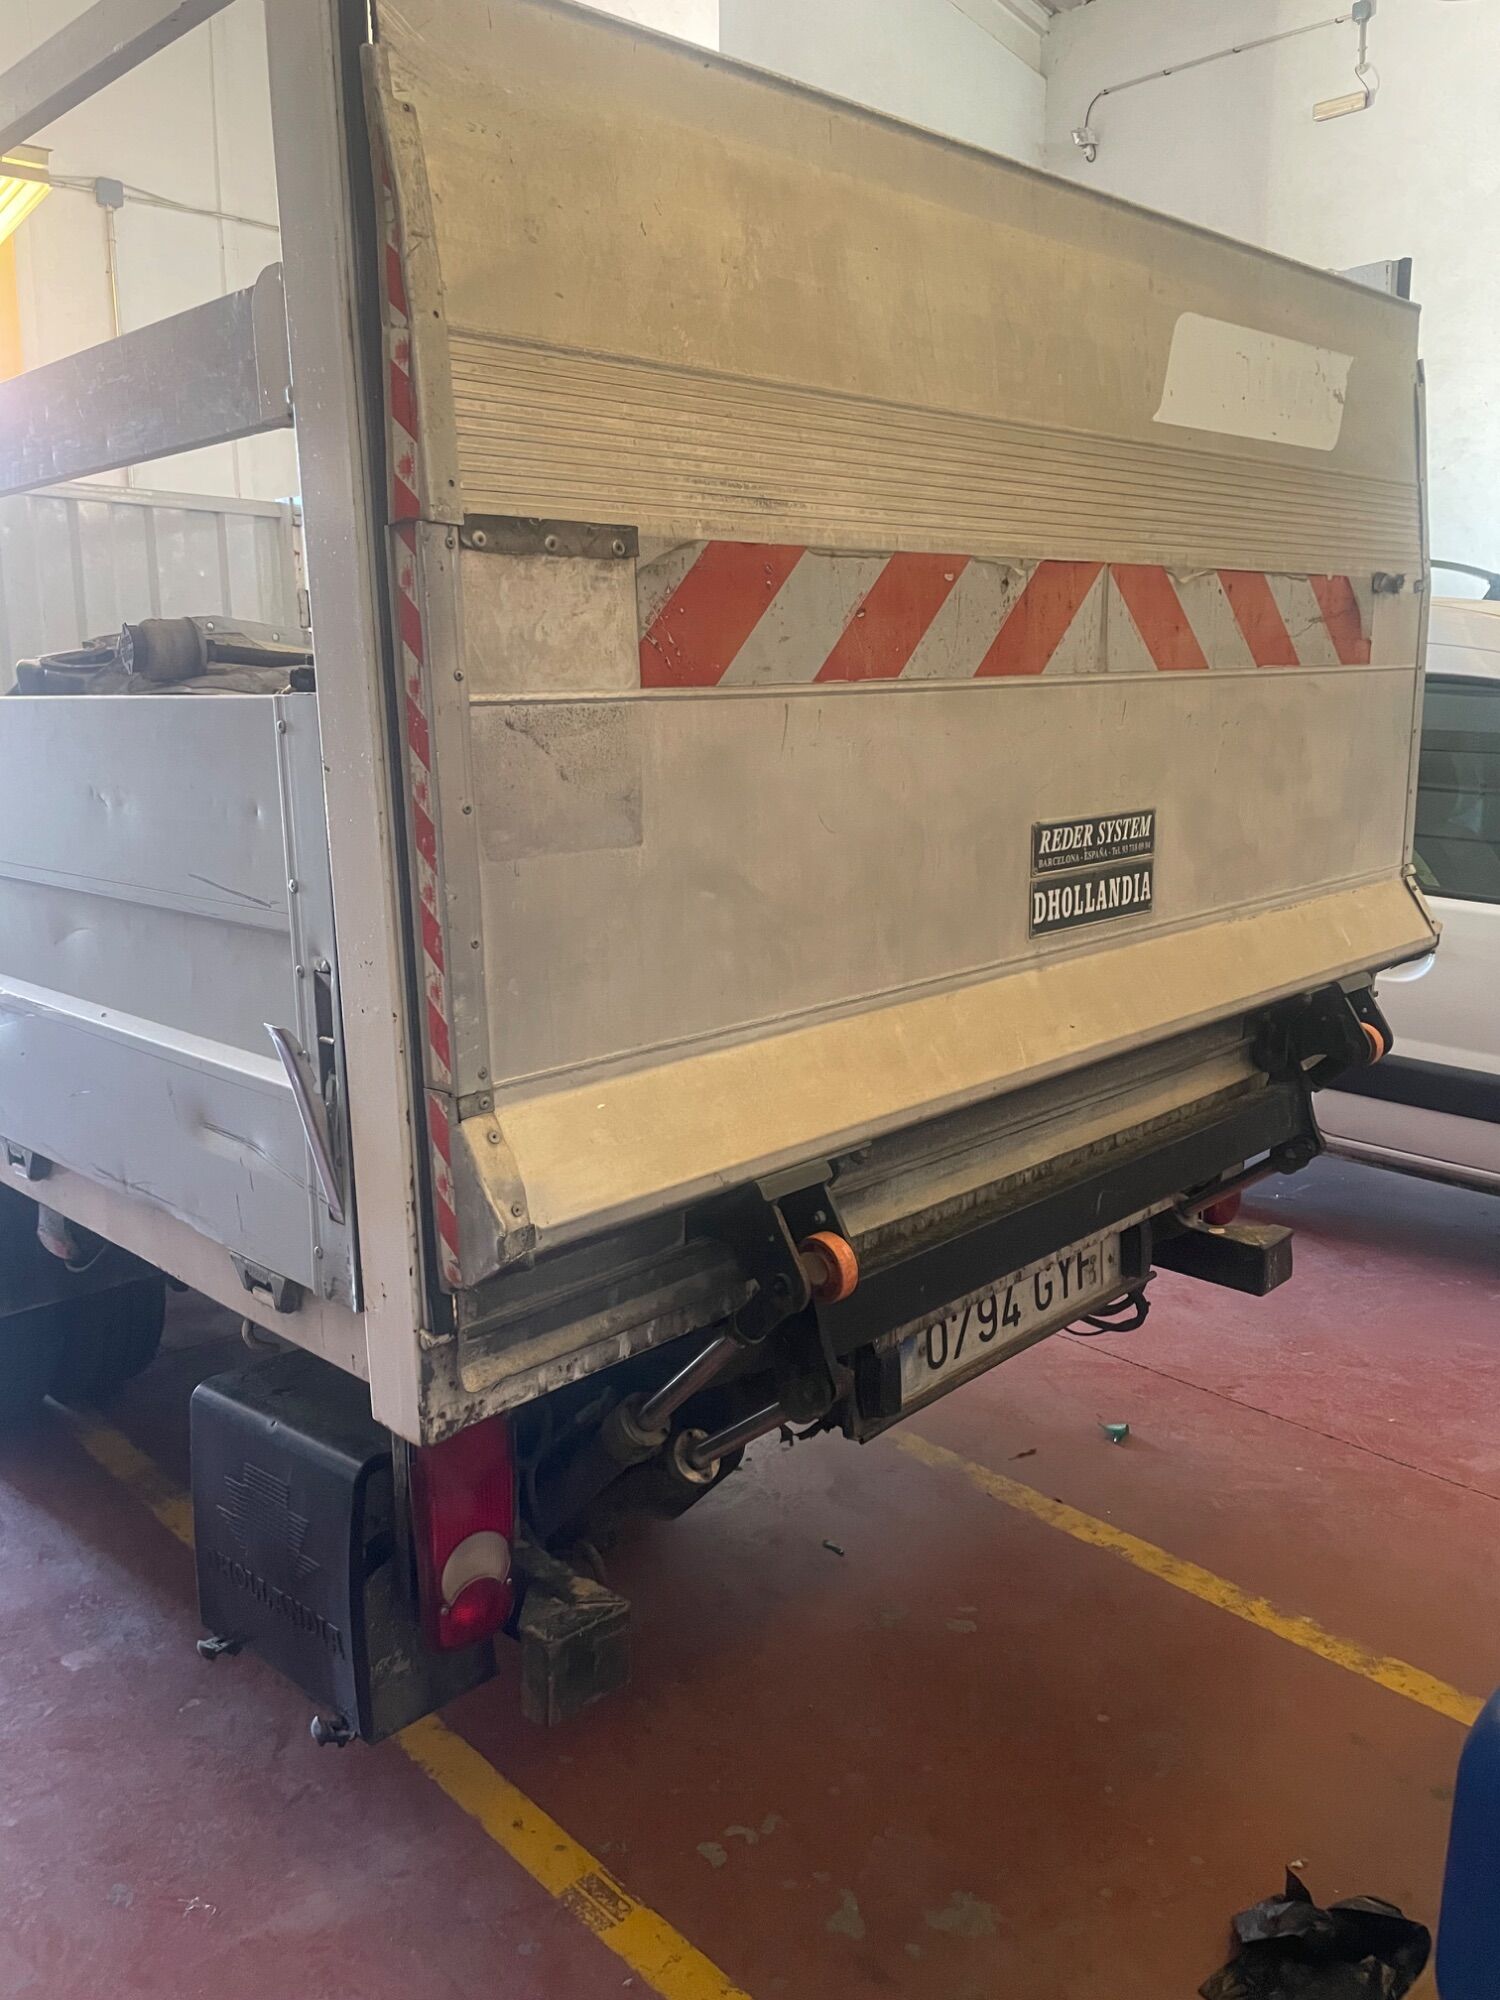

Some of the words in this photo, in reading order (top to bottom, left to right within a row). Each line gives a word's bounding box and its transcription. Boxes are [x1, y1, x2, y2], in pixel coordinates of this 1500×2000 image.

[1038, 823, 1094, 854] REDER
[1096, 814, 1153, 845] SYSTEM
[1038, 854, 1080, 868] BARCELONA
[1084, 847, 1108, 861] ESPAÑA
[1033, 871, 1152, 925] DHOLLANDIA
[925, 1284, 1021, 1371] 0794
